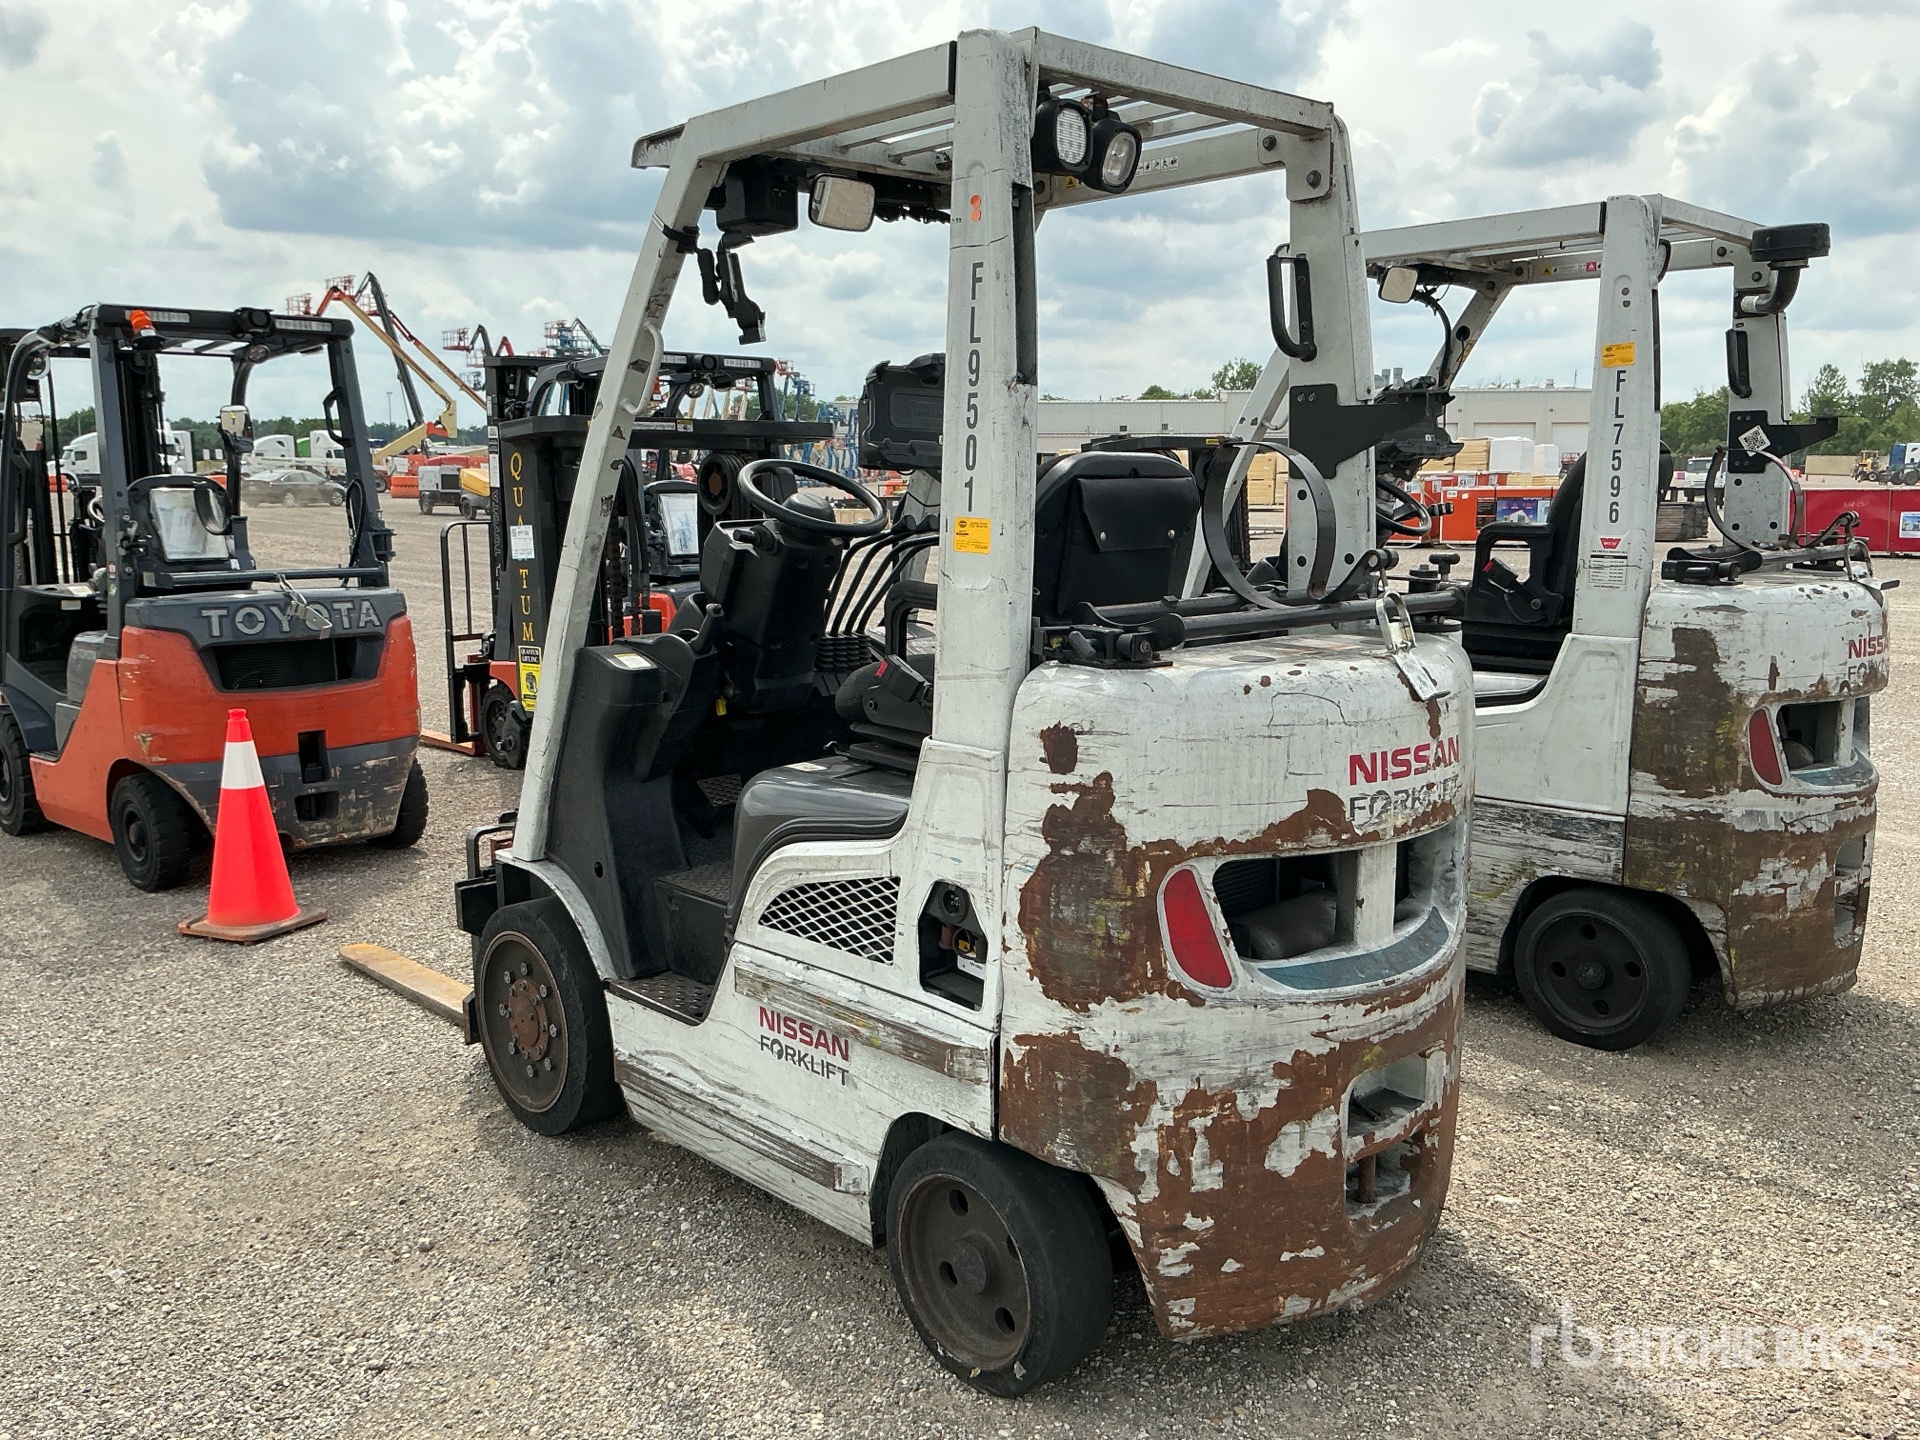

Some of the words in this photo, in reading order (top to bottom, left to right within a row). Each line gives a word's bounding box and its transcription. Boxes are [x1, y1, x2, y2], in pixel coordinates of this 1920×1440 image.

[964, 262, 984, 512] FL9501
[1609, 370, 1627, 523] FL7596
[510, 452, 535, 642] QUATUM
[1350, 735, 1460, 786] NISSAN
[1349, 774, 1460, 822] FORKIFT
[760, 1005, 850, 1063] NISSAN
[760, 1034, 850, 1087] FORKLIFT
